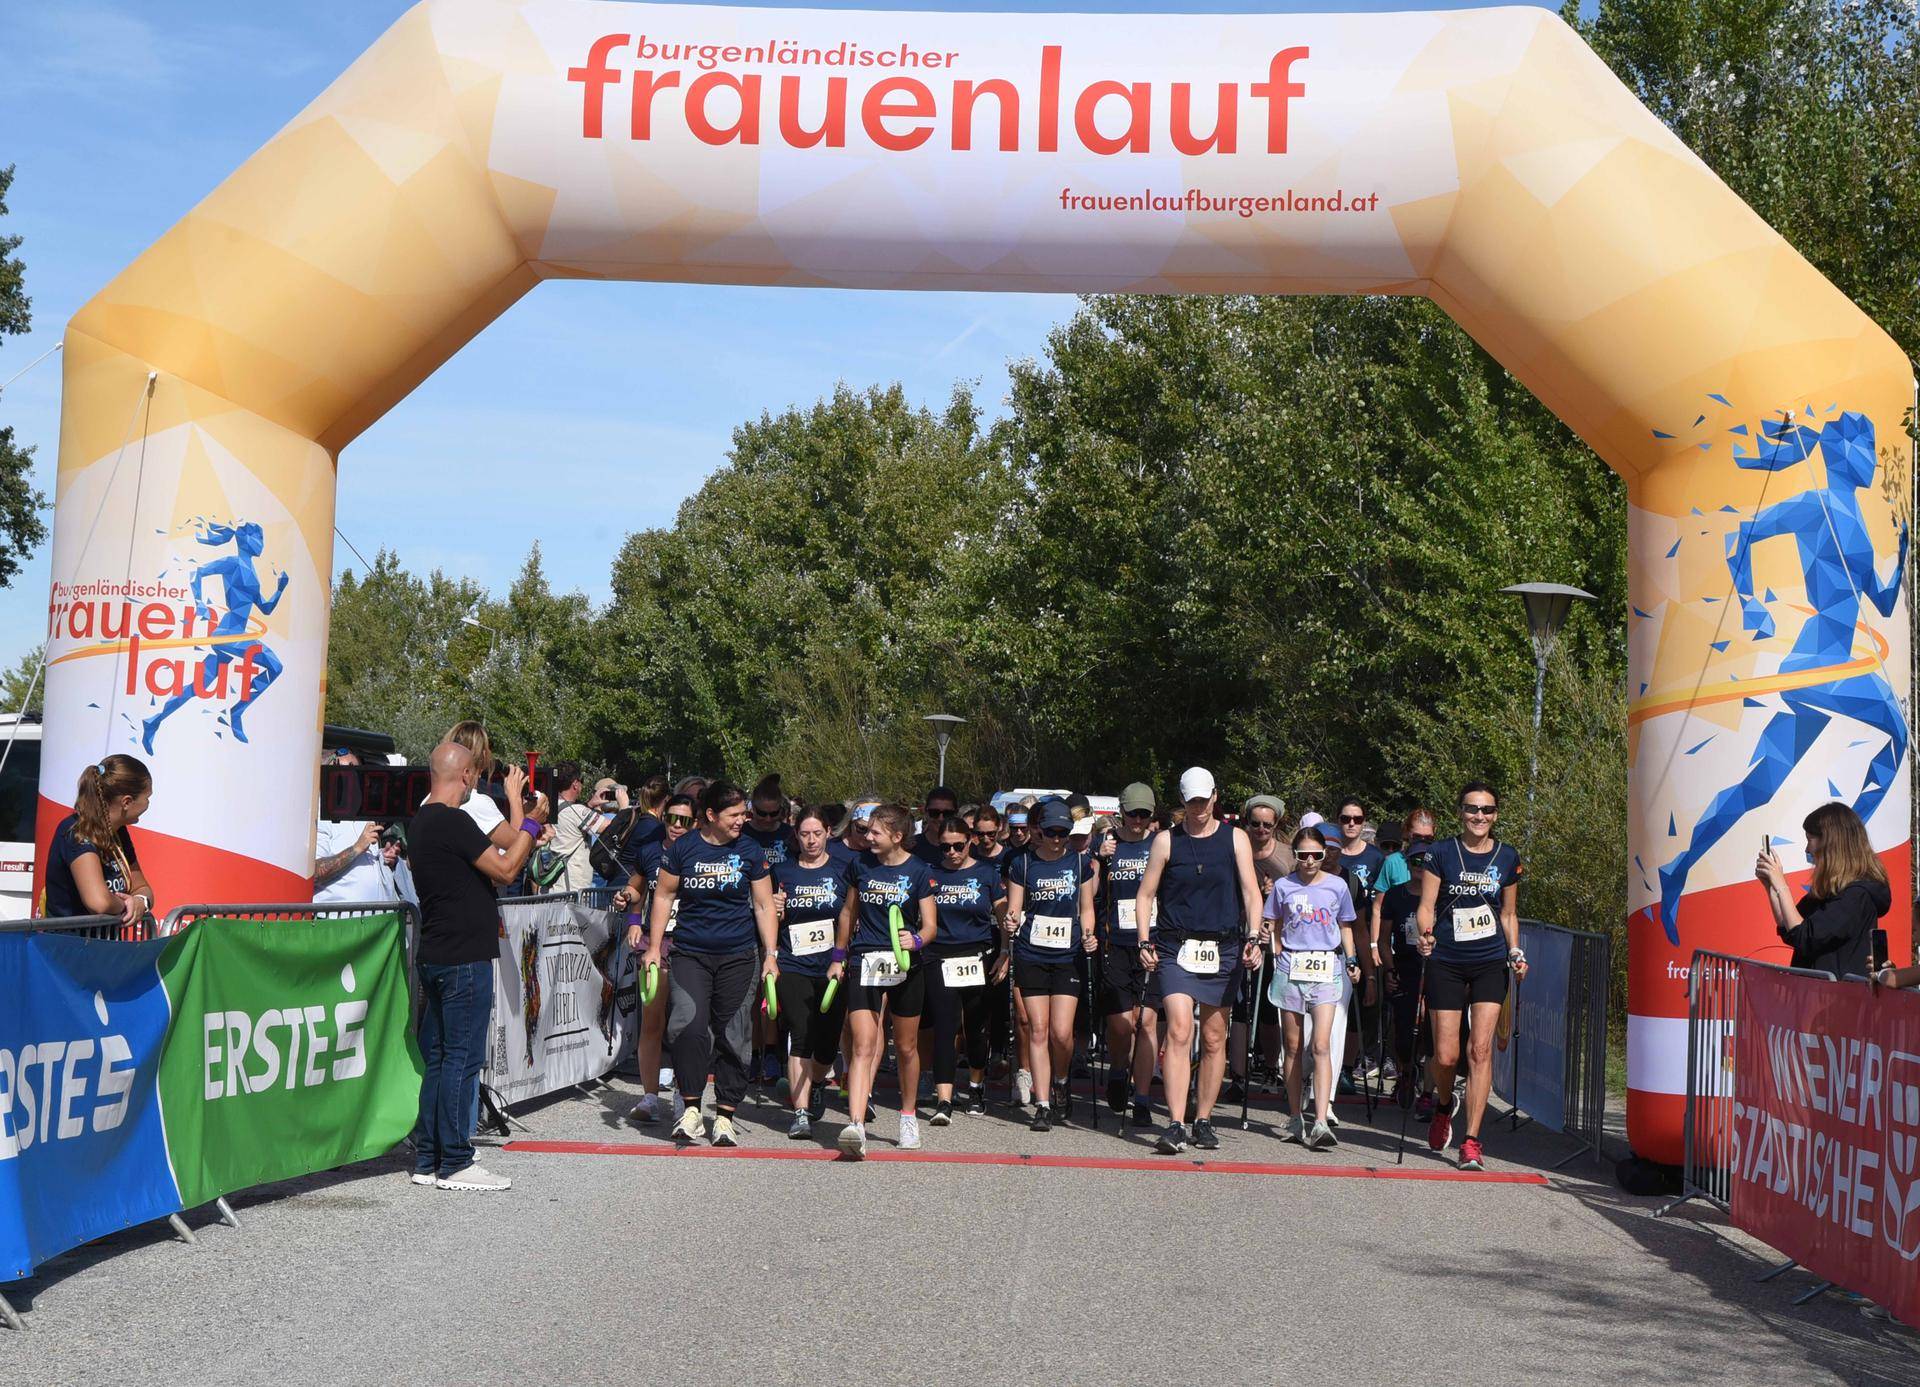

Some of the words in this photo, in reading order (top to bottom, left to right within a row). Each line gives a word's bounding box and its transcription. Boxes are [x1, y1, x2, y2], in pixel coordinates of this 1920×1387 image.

[636, 34, 959, 71] burgenländischer
[567, 33, 1309, 156] frauenlauf
[1059, 188, 1380, 218] frauenlaufburgenland.at
[48, 582, 218, 641] frauen
[125, 635, 264, 702] lauf
[683, 877, 716, 889] 2026
[1030, 890, 1056, 901] 2026
[1448, 885, 1477, 896] 2026
[935, 894, 957, 905] 026
[1468, 914, 1491, 929] 140
[809, 930, 826, 943] 23
[1045, 925, 1066, 938] 141
[1194, 949, 1215, 962] 190
[877, 962, 900, 975] 413
[956, 964, 978, 977] 310
[1305, 958, 1327, 971] 261
[203, 1005, 327, 1101] ERSTE
[1767, 1024, 1883, 1132] WIENER
[1731, 1101, 1880, 1238] STÄDTISCHE
